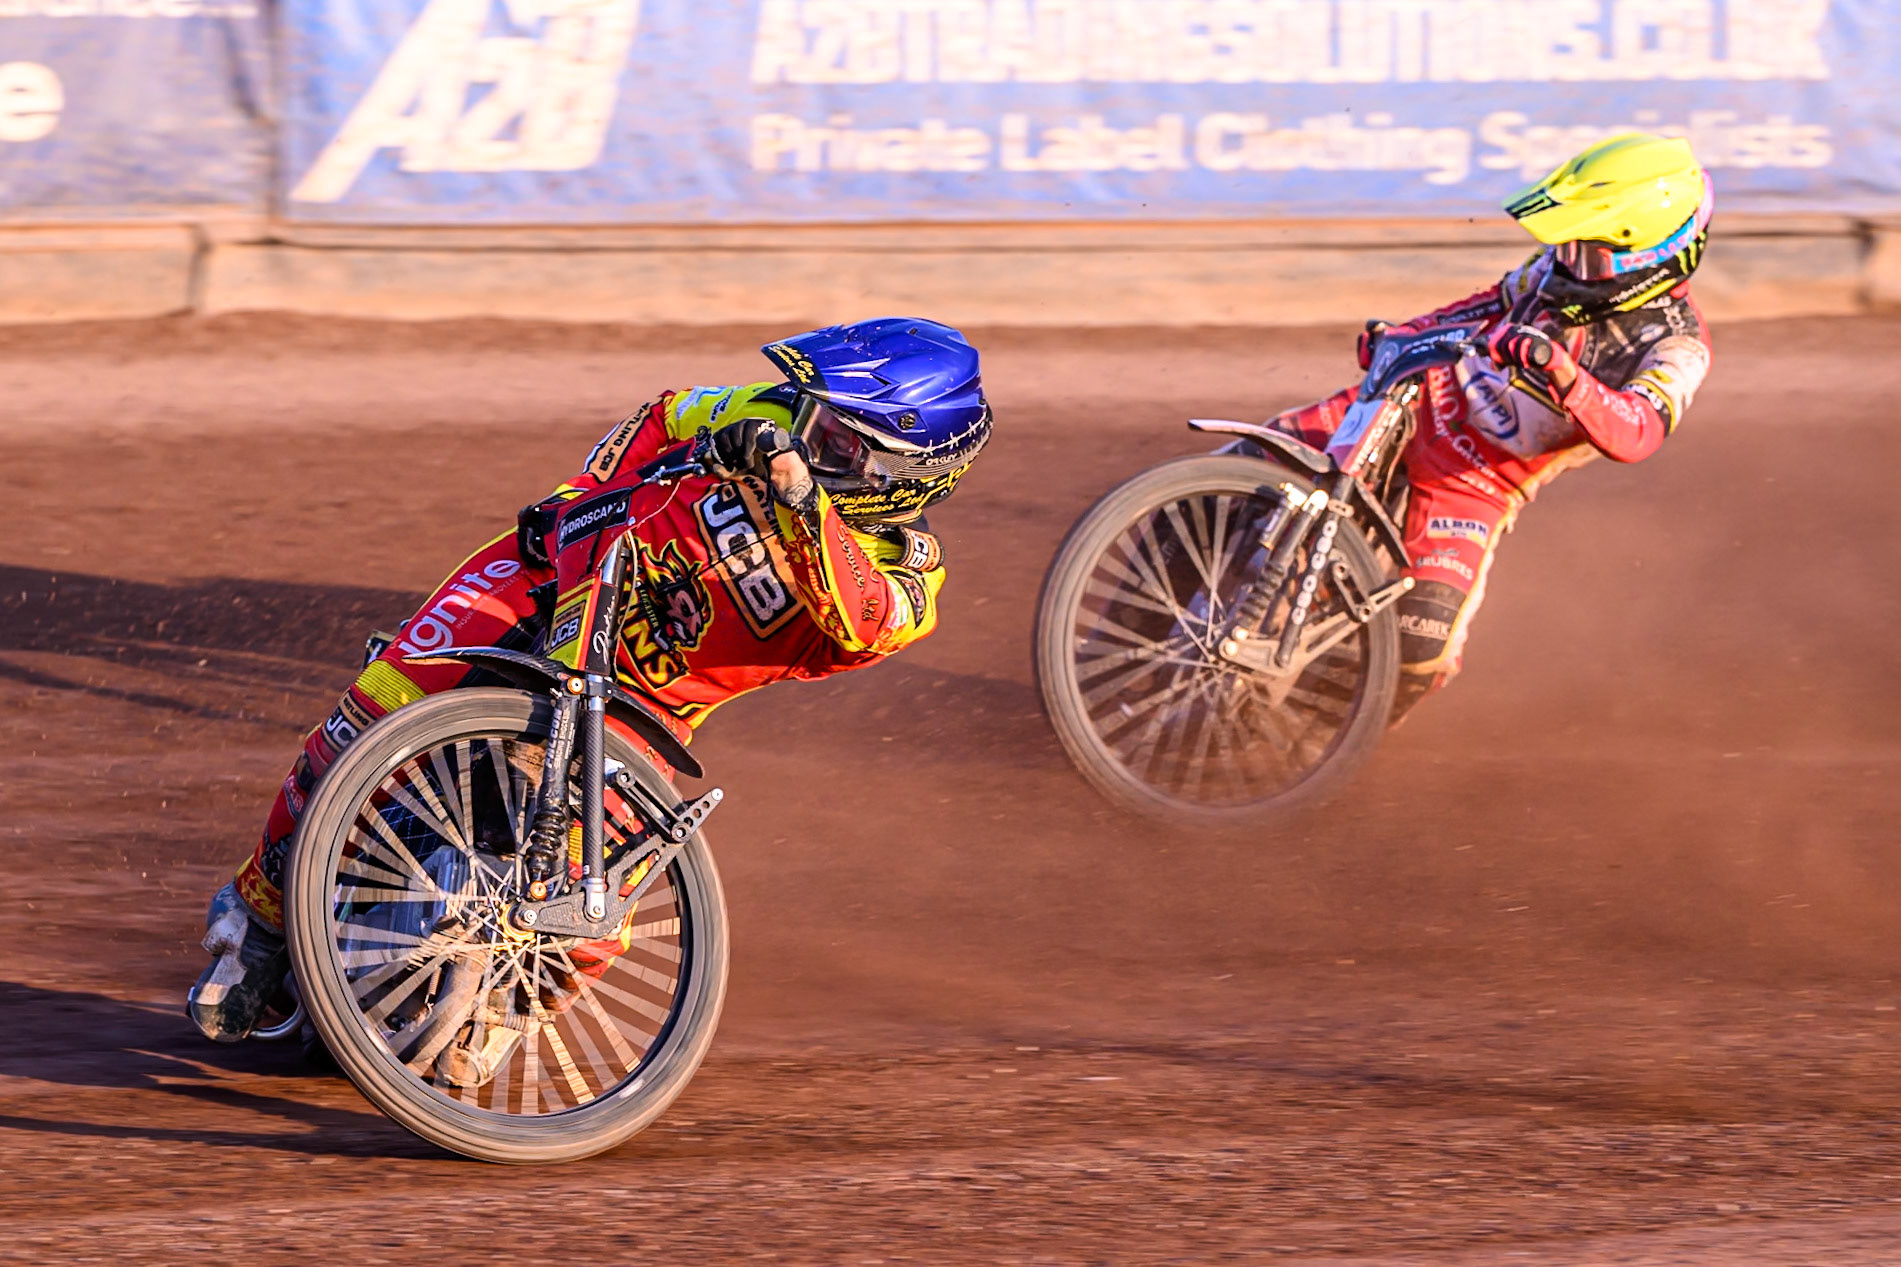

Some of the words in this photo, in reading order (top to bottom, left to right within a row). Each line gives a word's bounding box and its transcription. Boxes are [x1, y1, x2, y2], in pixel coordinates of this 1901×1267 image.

[751, 113, 990, 171] Private
[1001, 113, 1189, 171] Label
[1195, 112, 1470, 185] Clothing
[1479, 110, 1833, 183] Spelists
[829, 493, 887, 509] Complete
[891, 488, 917, 502] Car
[841, 503, 895, 515] Services
[898, 493, 924, 508] Ltd
[702, 494, 787, 621] JCB
[551, 617, 580, 647] JCB
[326, 714, 358, 748] JC
[545, 707, 563, 769] FALCON
